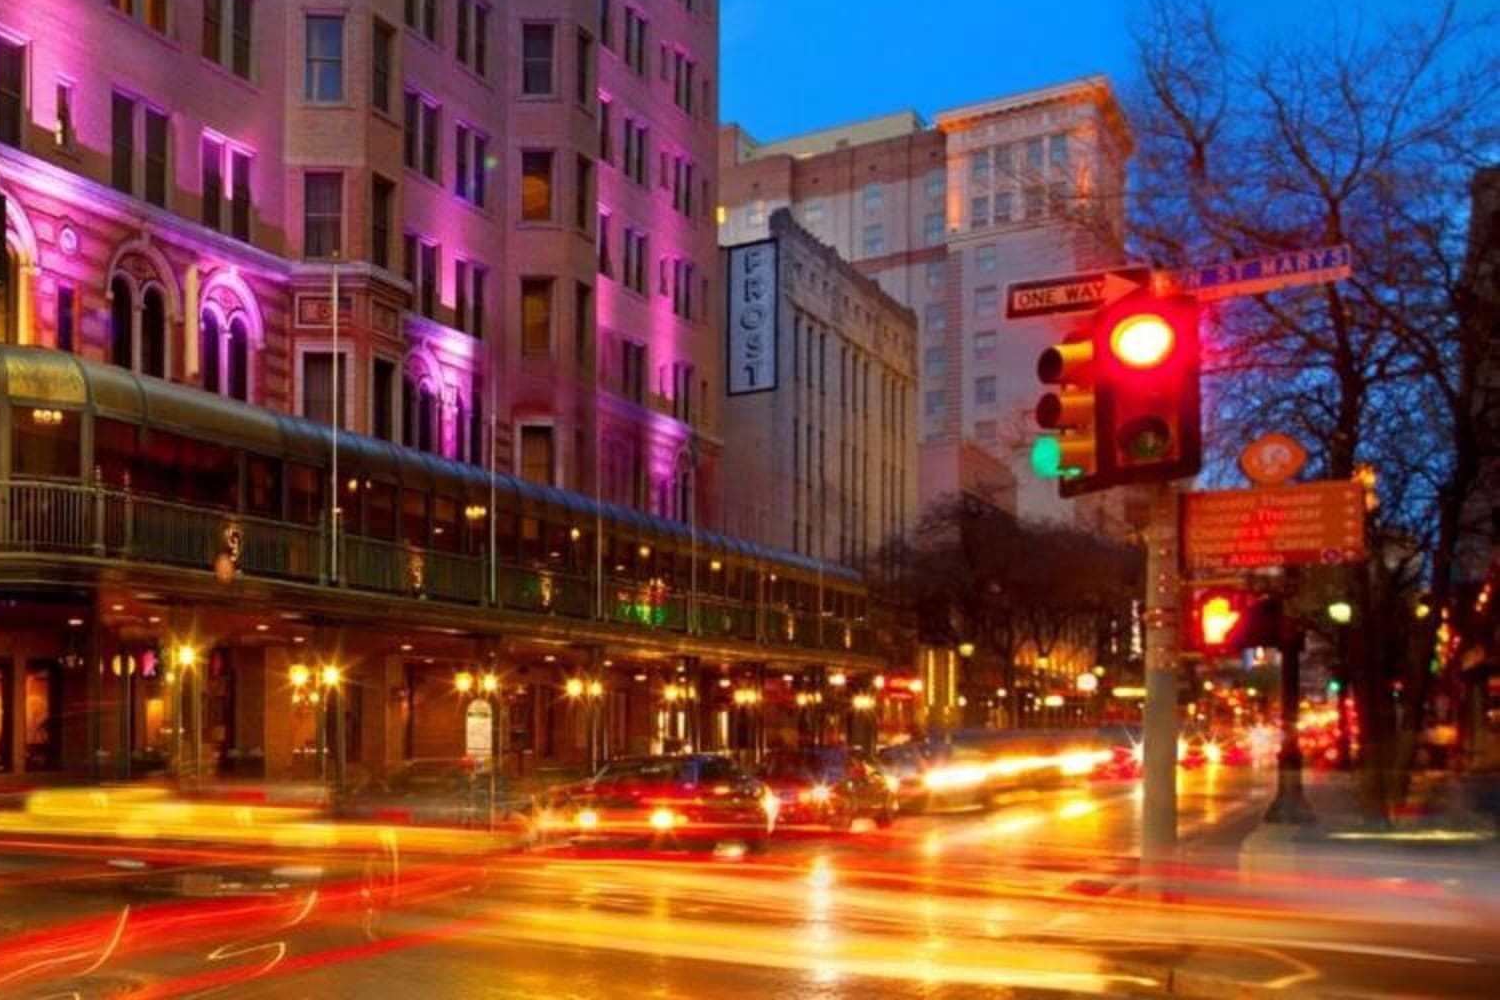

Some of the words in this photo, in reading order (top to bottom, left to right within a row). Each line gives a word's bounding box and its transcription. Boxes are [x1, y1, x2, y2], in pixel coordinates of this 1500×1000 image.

[1218, 264, 1242, 281] ST
[1017, 290, 1055, 306] ONE
[1065, 282, 1105, 301] WAY
[739, 250, 765, 387] FROST
